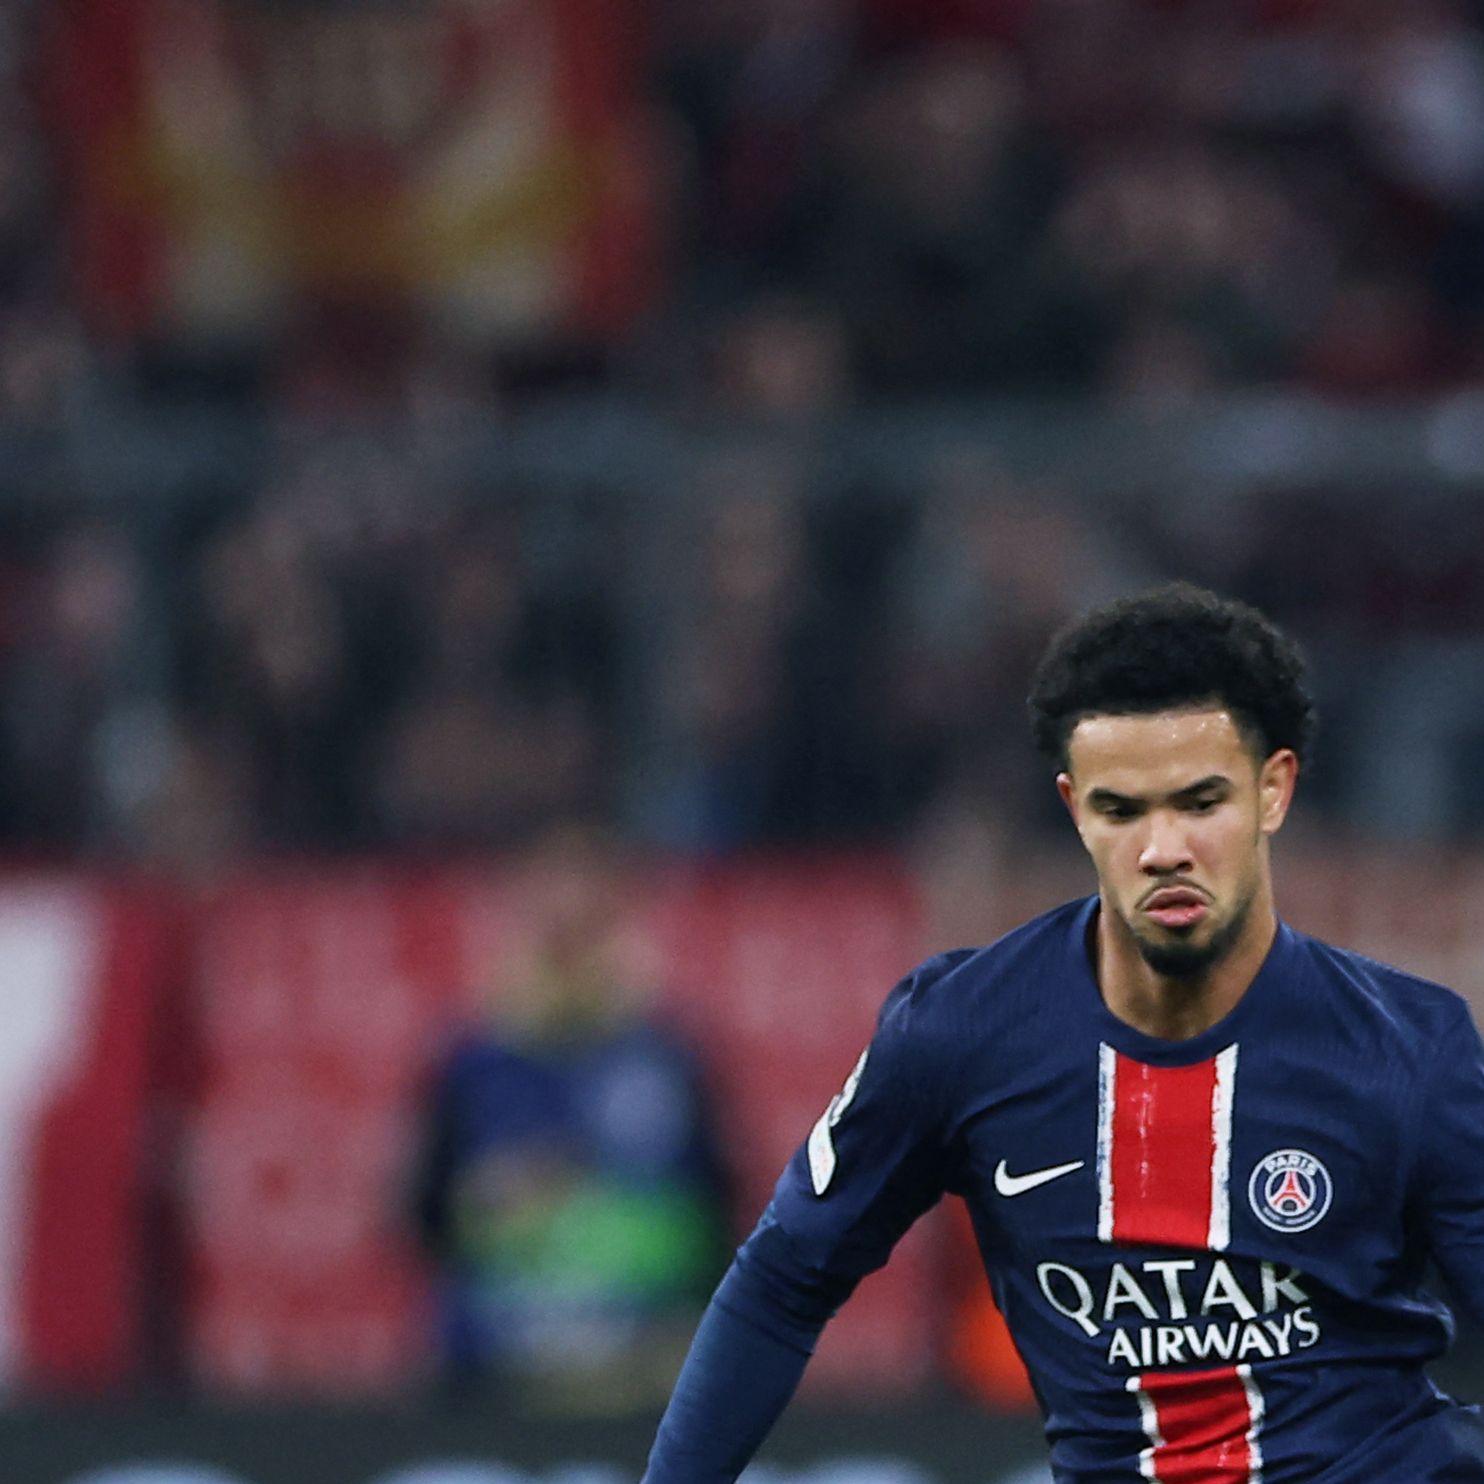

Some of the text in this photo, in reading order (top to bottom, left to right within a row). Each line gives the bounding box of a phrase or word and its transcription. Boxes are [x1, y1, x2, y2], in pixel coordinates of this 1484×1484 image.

[1264, 1155, 1317, 1176] PARIS
[1036, 1258, 1309, 1338] QATAR
[1108, 1306, 1320, 1367] AIRWAYS
